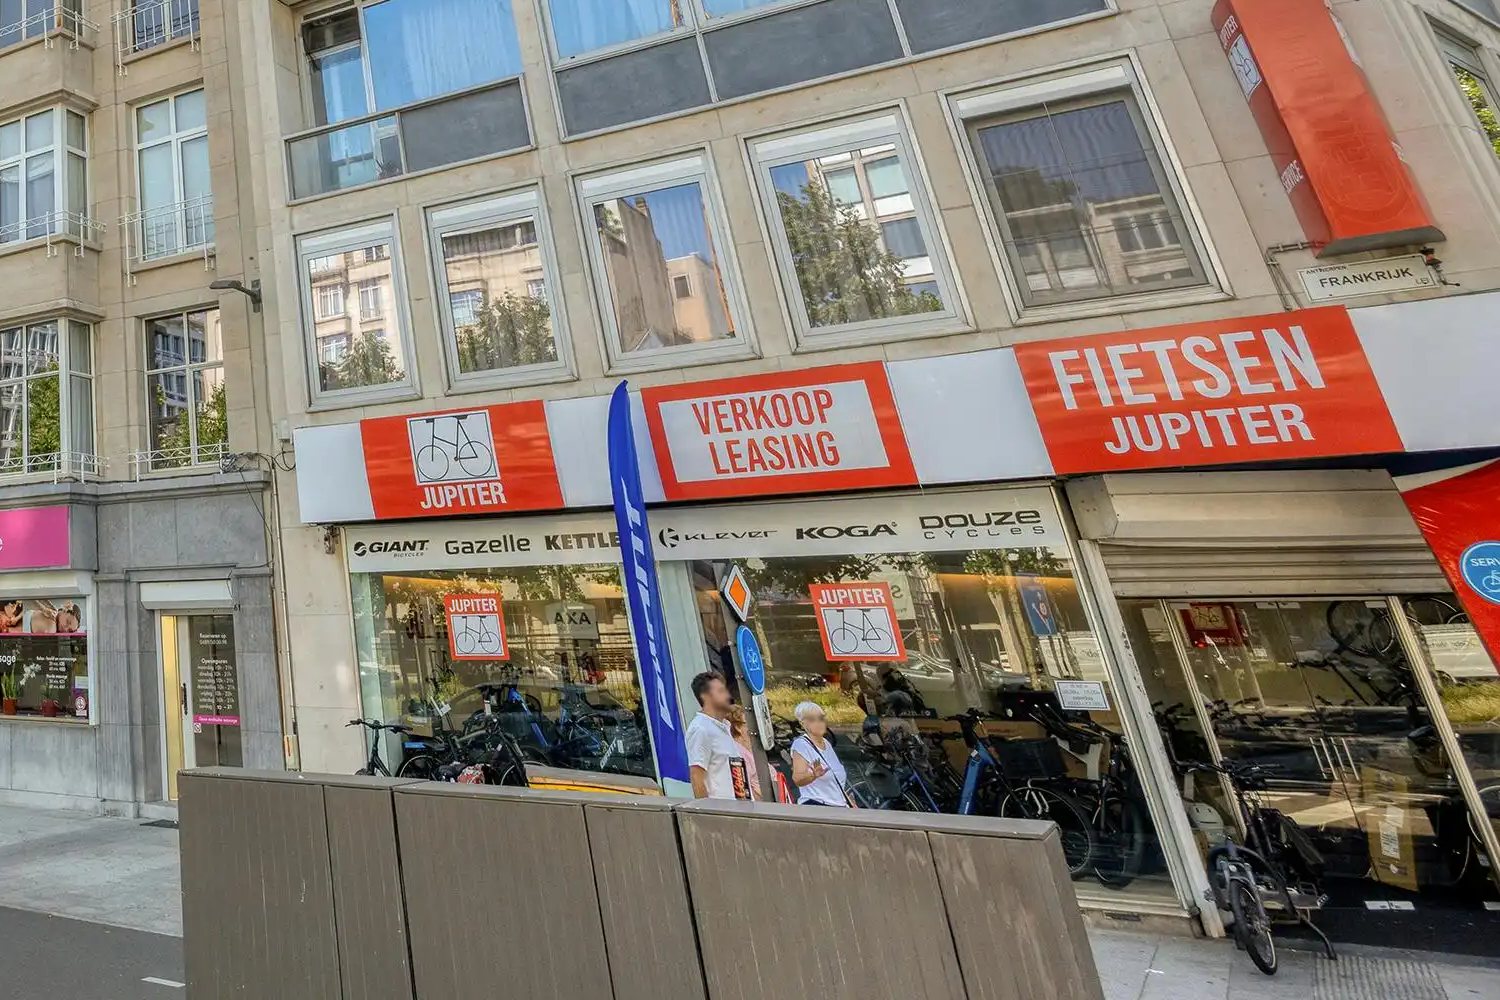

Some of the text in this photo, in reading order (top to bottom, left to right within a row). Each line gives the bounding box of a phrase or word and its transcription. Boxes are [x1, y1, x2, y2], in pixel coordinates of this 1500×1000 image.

[1319, 267, 1414, 289] FRANKRIJK
[1048, 325, 1326, 411] FIETSEN
[691, 388, 834, 436] VERKOOP
[1104, 402, 1316, 455] JUPITER
[708, 430, 841, 475] LEASING
[420, 482, 508, 509] JUPITER
[796, 523, 898, 540] KOGA
[369, 539, 429, 553] GIANT
[445, 534, 531, 555] Gazelle
[449, 597, 498, 613] JUPITER
[818, 587, 886, 605] JUPITER
[554, 610, 591, 625] AXA
